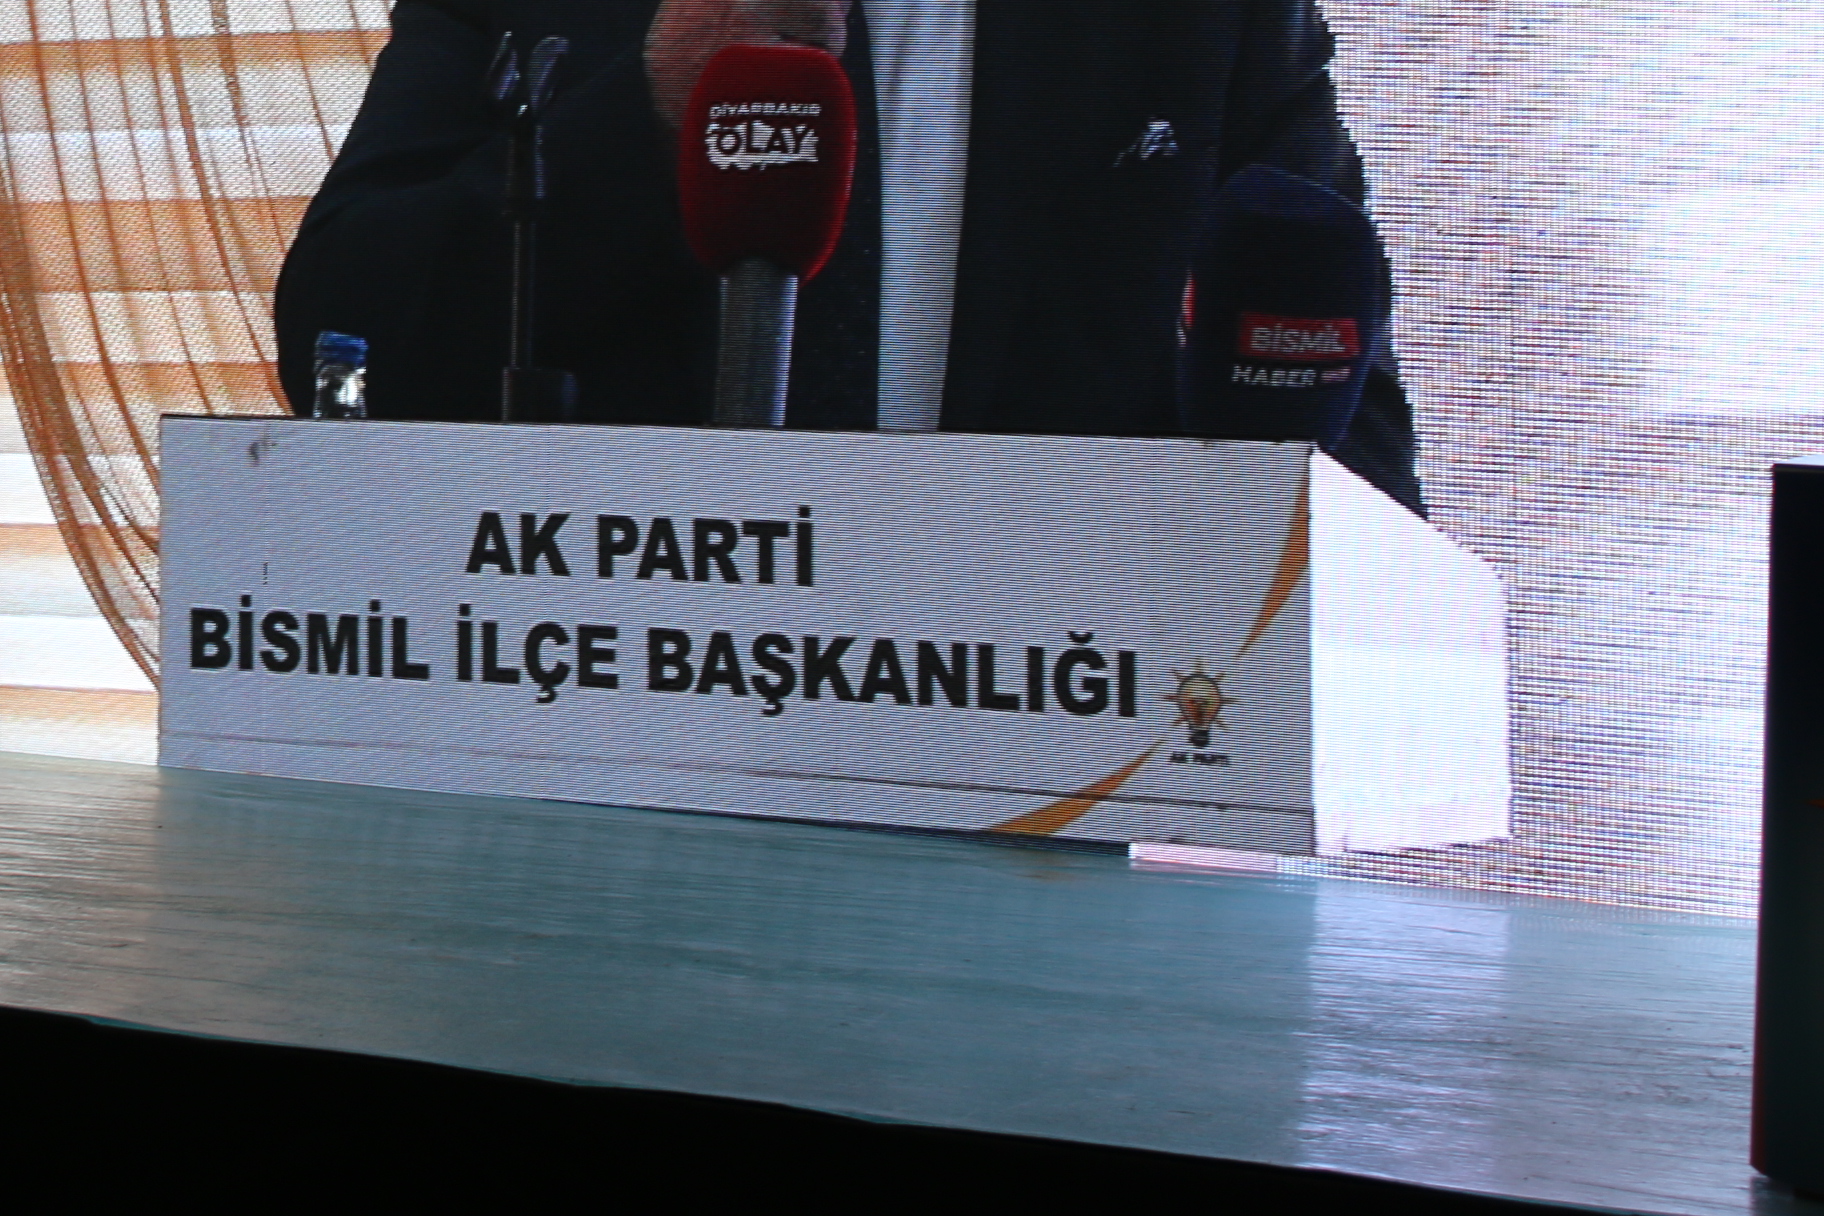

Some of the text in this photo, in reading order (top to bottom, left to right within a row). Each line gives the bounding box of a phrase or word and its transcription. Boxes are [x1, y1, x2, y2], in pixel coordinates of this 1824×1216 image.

[1231, 363, 1317, 388] HABER
[465, 504, 815, 588] AK PARTİ
[189, 593, 1138, 718] BİSMİL İLÇE BAŞKANLIĞI
